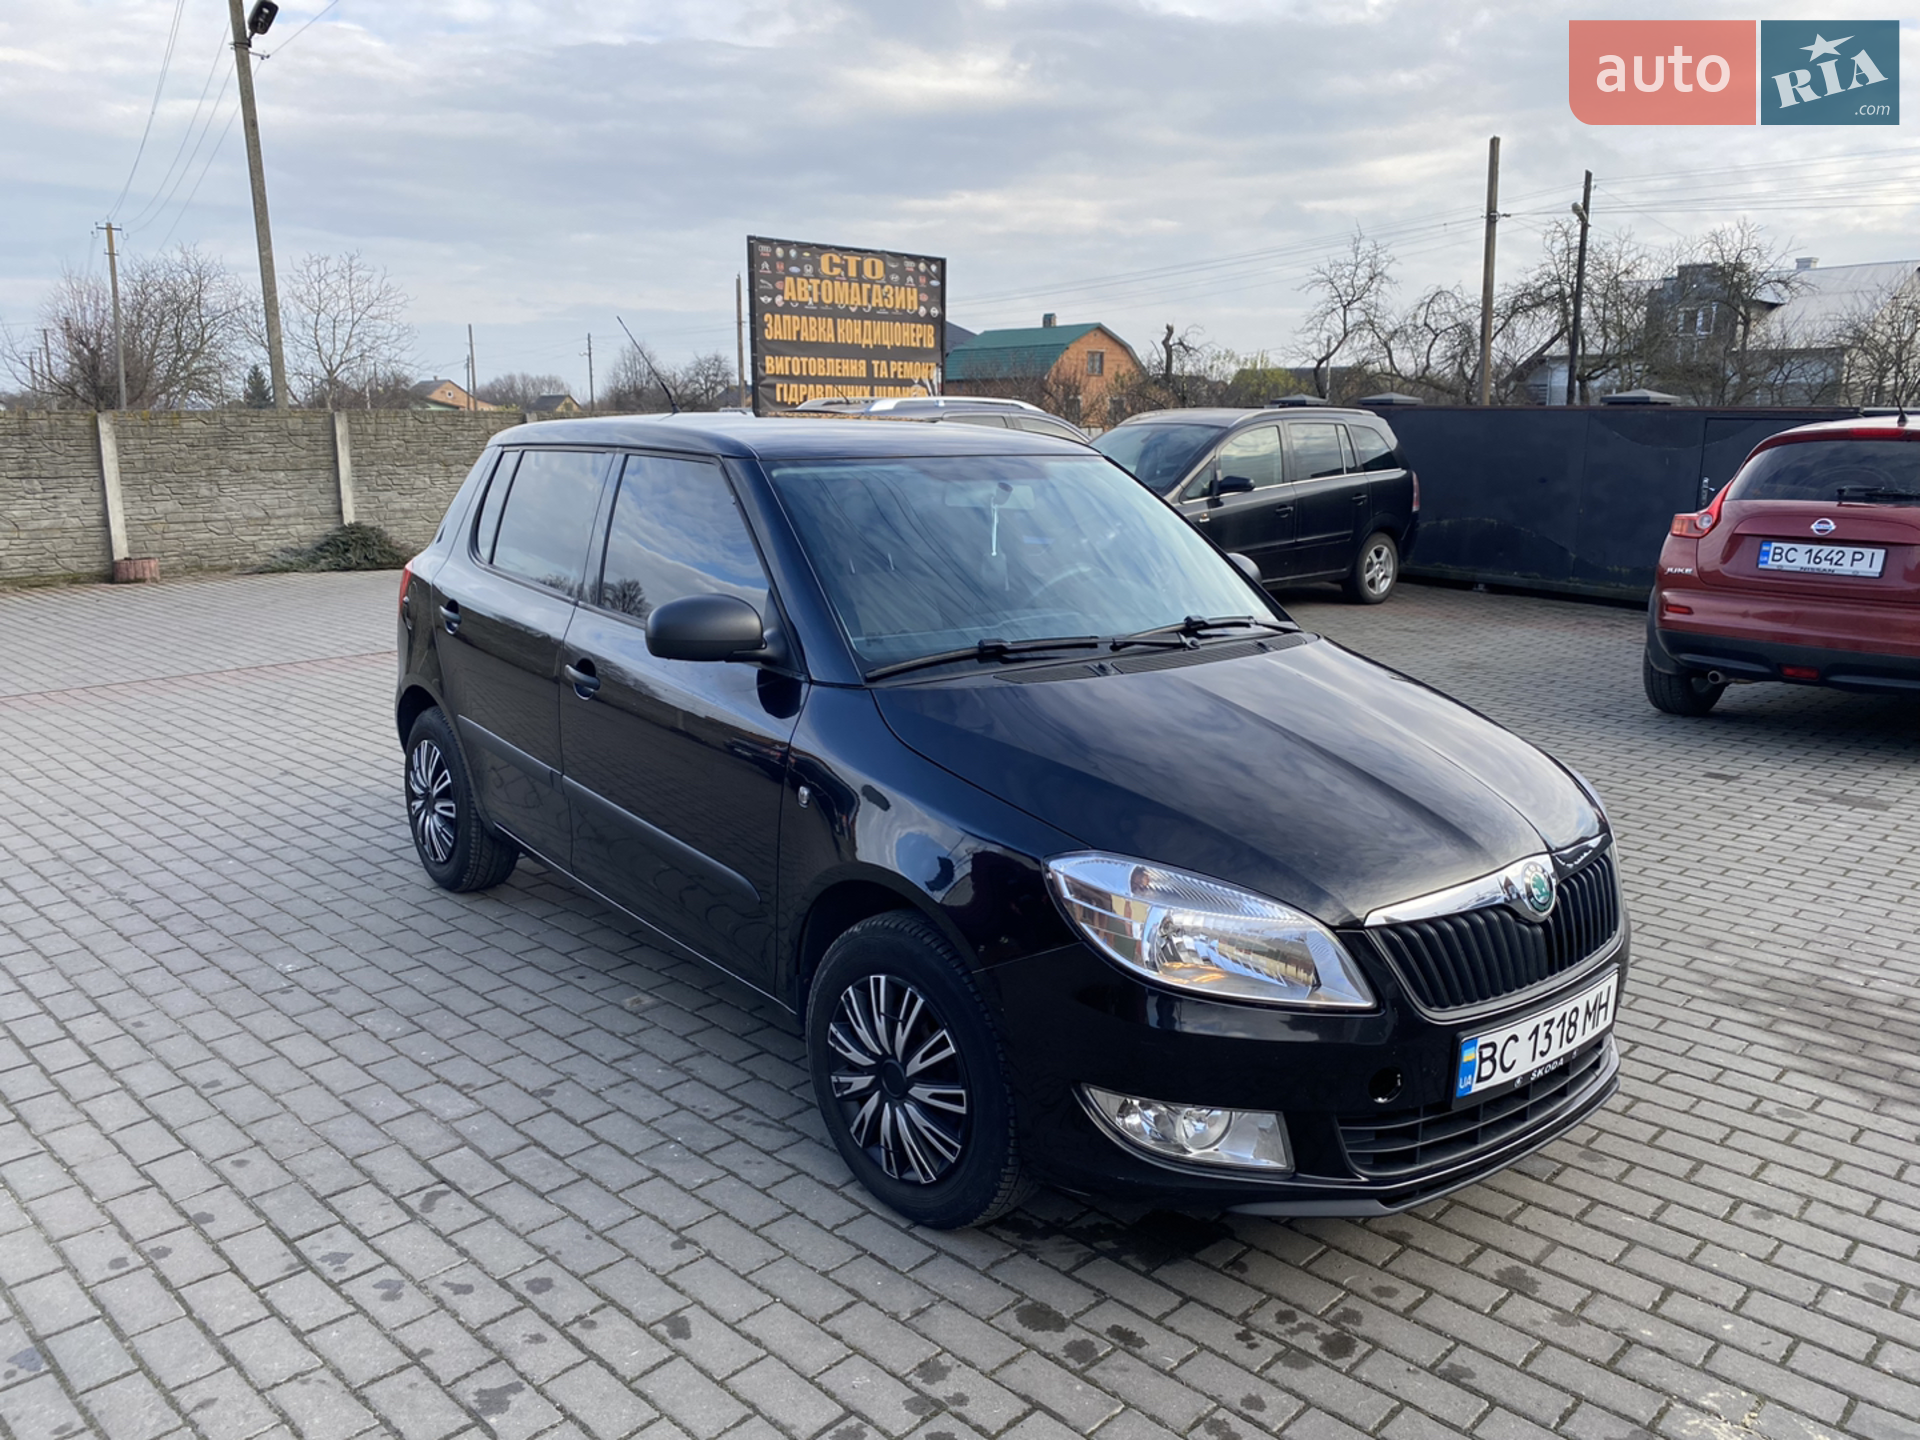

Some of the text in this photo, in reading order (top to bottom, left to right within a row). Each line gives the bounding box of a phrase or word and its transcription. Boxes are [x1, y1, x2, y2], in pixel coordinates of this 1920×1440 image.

[820, 252, 885, 280] СТО
[783, 276, 918, 310] АВТОМАГАЗИН
[764, 313, 935, 349] ЗАПРАВКА КОНДИЦІОНЕРІВ
[765, 355, 936, 380] ВИГОТОВЛЕННЯ ТА РЕМОНТ
[1771, 546, 1799, 563] BC
[1804, 548, 1845, 567] 1642
[1475, 985, 1612, 1084] BC 1318 MH
[1459, 1074, 1473, 1089] UA
